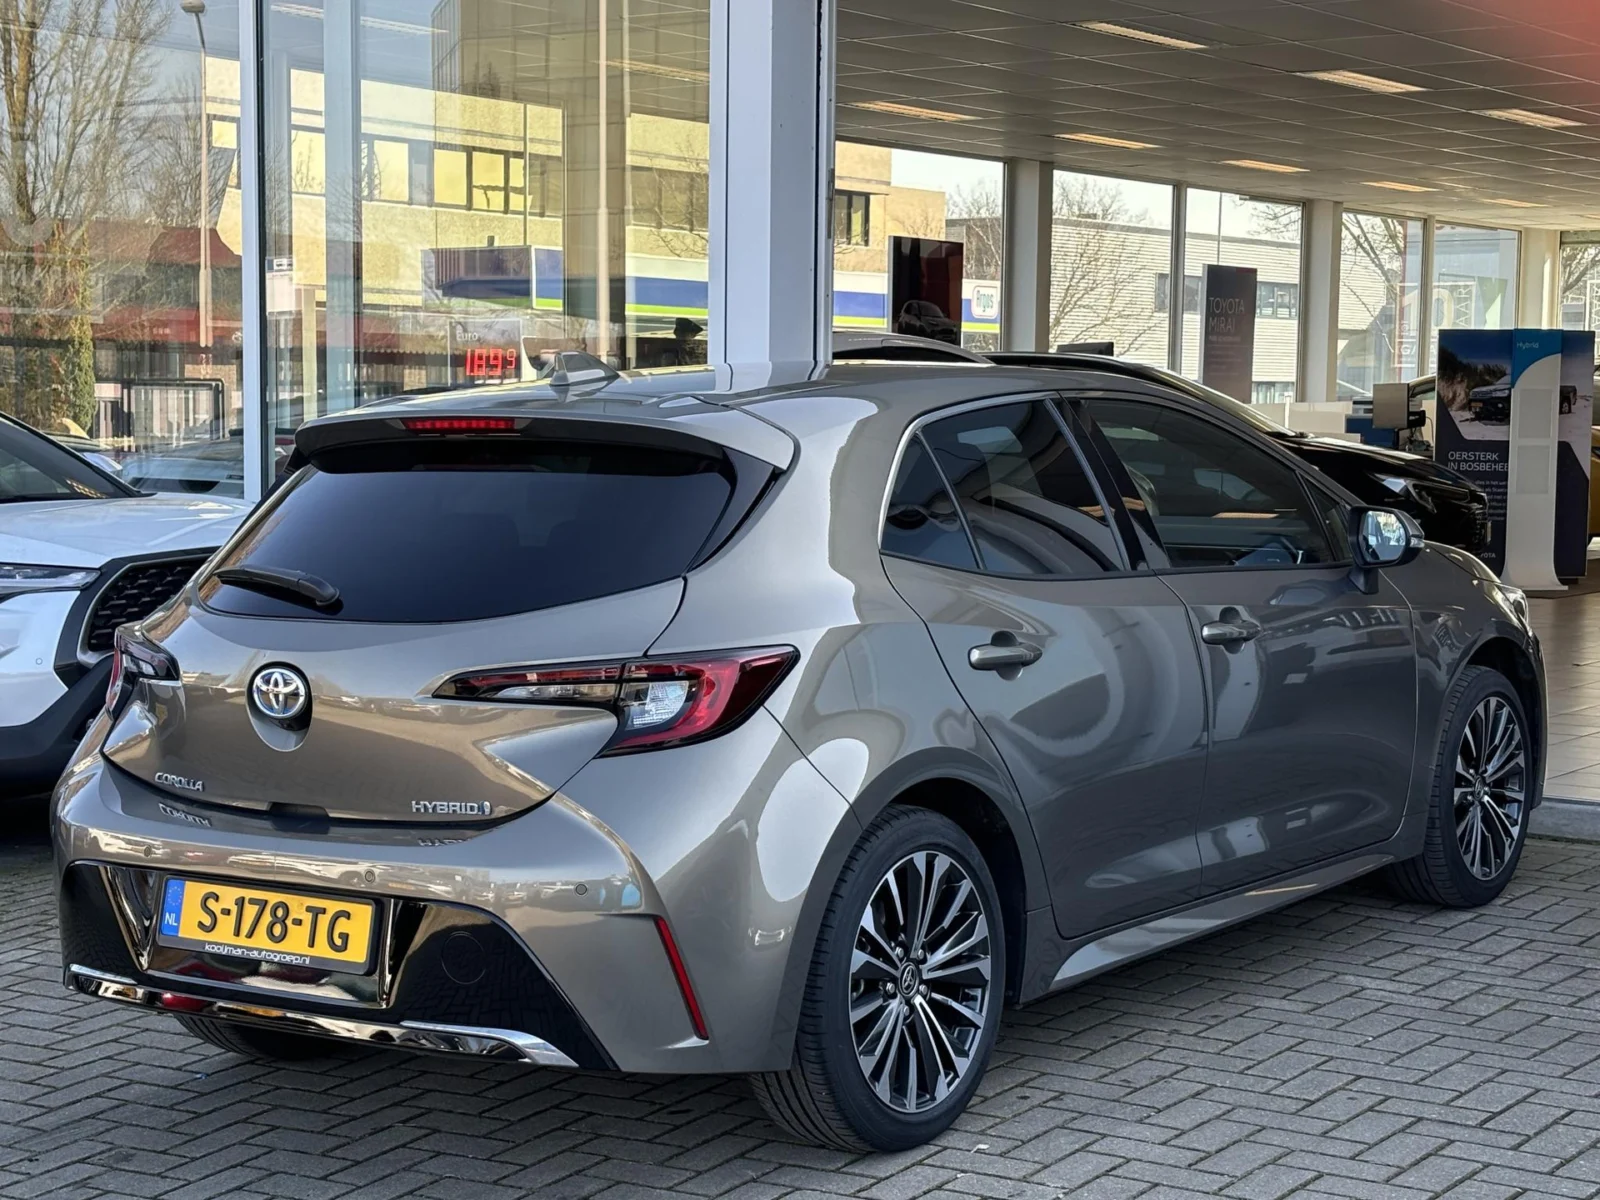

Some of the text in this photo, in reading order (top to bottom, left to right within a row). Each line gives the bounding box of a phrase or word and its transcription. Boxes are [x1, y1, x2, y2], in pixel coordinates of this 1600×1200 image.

[1209, 297, 1245, 315] TOYOTA
[1455, 287, 1471, 328] AAR
[1208, 316, 1235, 333] MIRAI
[456, 331, 479, 341] Euro
[1516, 341, 1539, 350] Hybrid
[1448, 451, 1499, 461] OERSTERK
[1448, 462, 1508, 471] IN BOSBEHEE
[154, 772, 203, 792] COROLLA
[411, 800, 479, 815] HYBRID
[164, 912, 179, 926] NL
[197, 891, 351, 953] S-178-TG
[204, 942, 311, 965] kooijman-autogroep.nl
